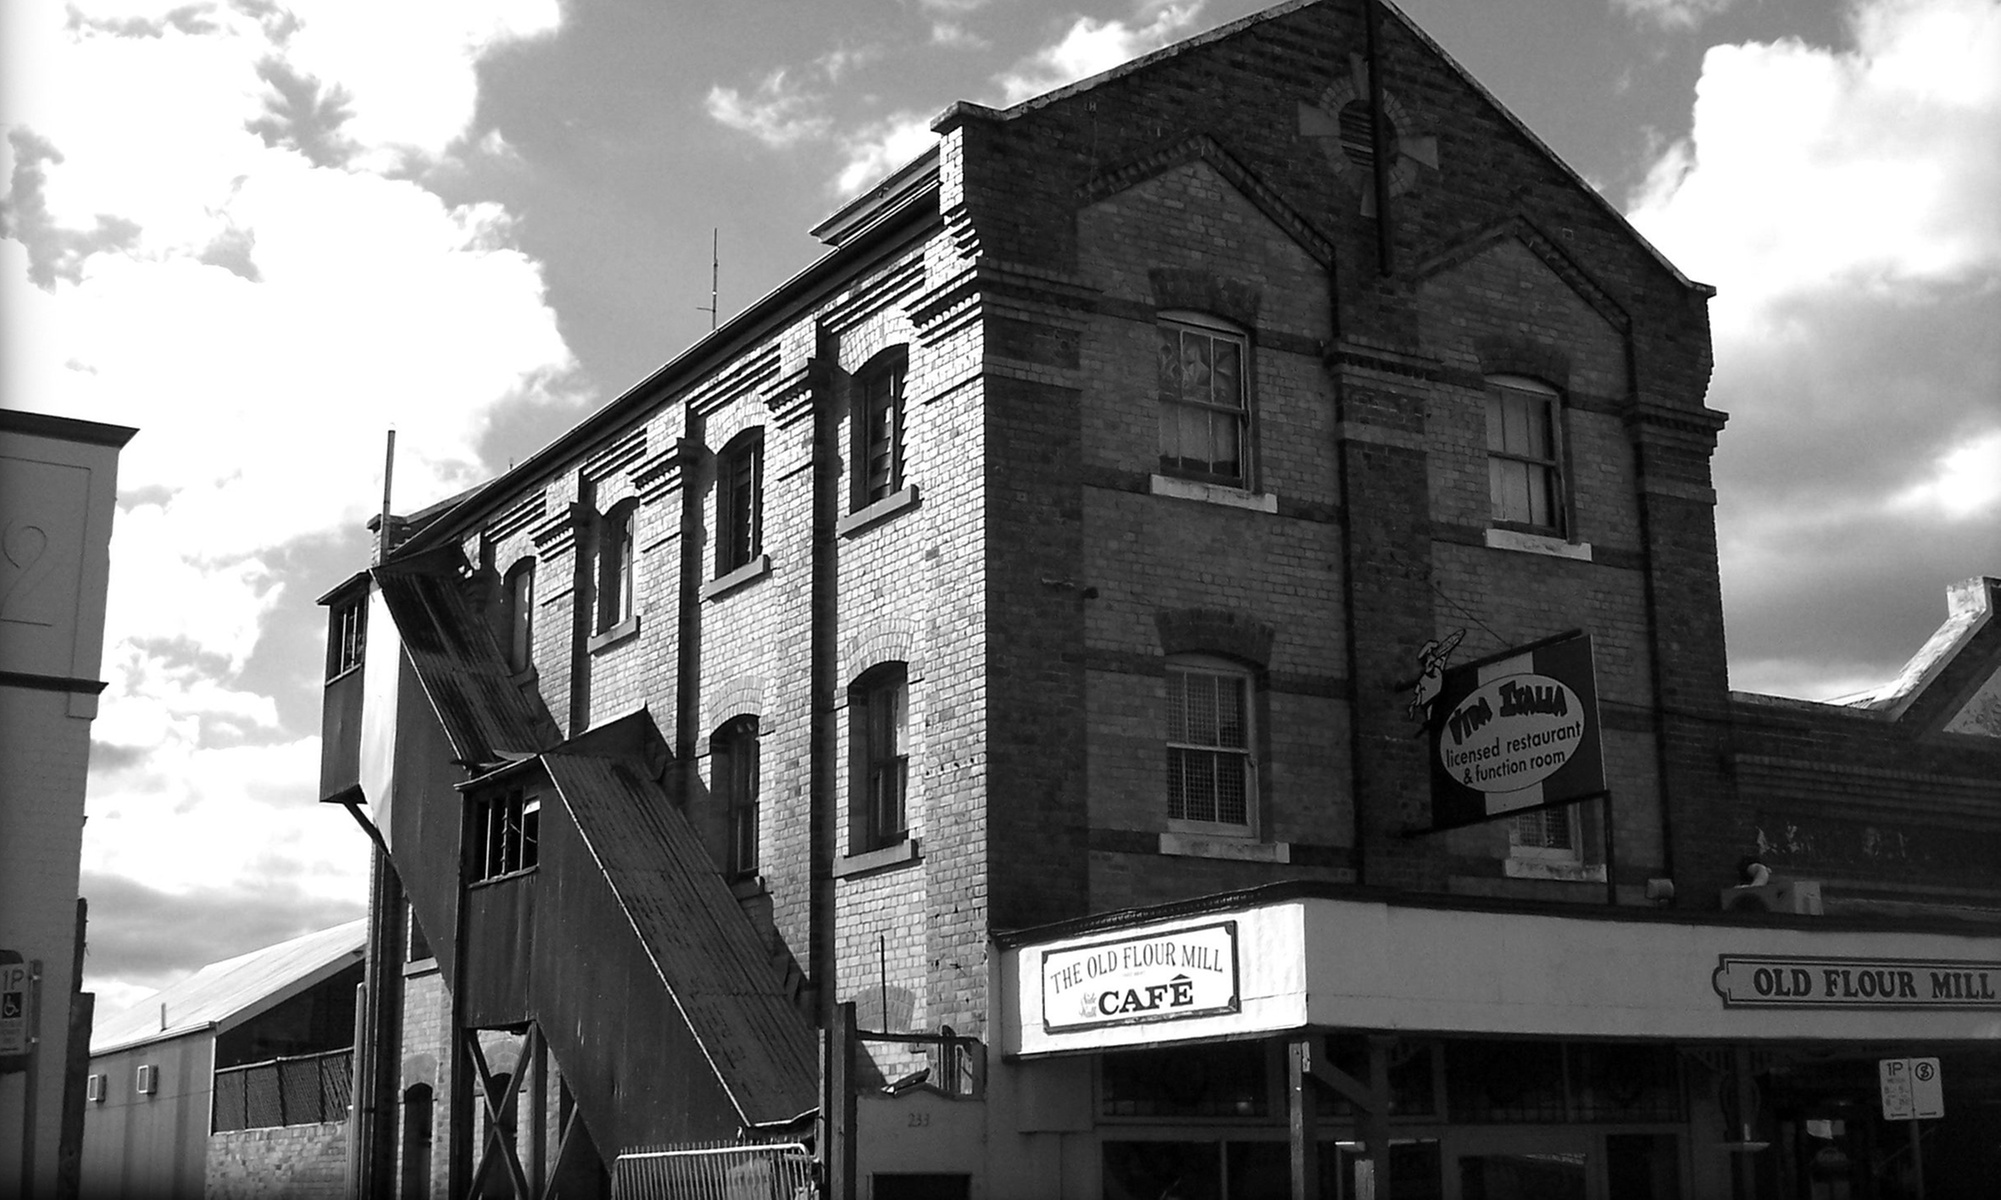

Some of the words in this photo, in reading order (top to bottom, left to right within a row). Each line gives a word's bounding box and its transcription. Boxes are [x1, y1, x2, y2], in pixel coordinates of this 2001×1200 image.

[1499, 680, 1568, 717] ITALIA
[1446, 737, 1500, 768] licensed
[1507, 721, 1582, 754] restaurant
[1463, 769, 1474, 785] &
[1475, 758, 1527, 783] function
[1530, 751, 1566, 770] room
[2, 968, 24, 991] 1P
[1050, 962, 1083, 994] THE
[1087, 950, 1118, 978] OLD
[1123, 942, 1177, 969] FLOUR
[1181, 945, 1223, 973] MILL
[1753, 967, 1812, 997] OLD
[1823, 969, 1917, 998] FLOUR
[1930, 971, 1995, 1000] MILL
[1886, 1061, 1904, 1076] 1P
